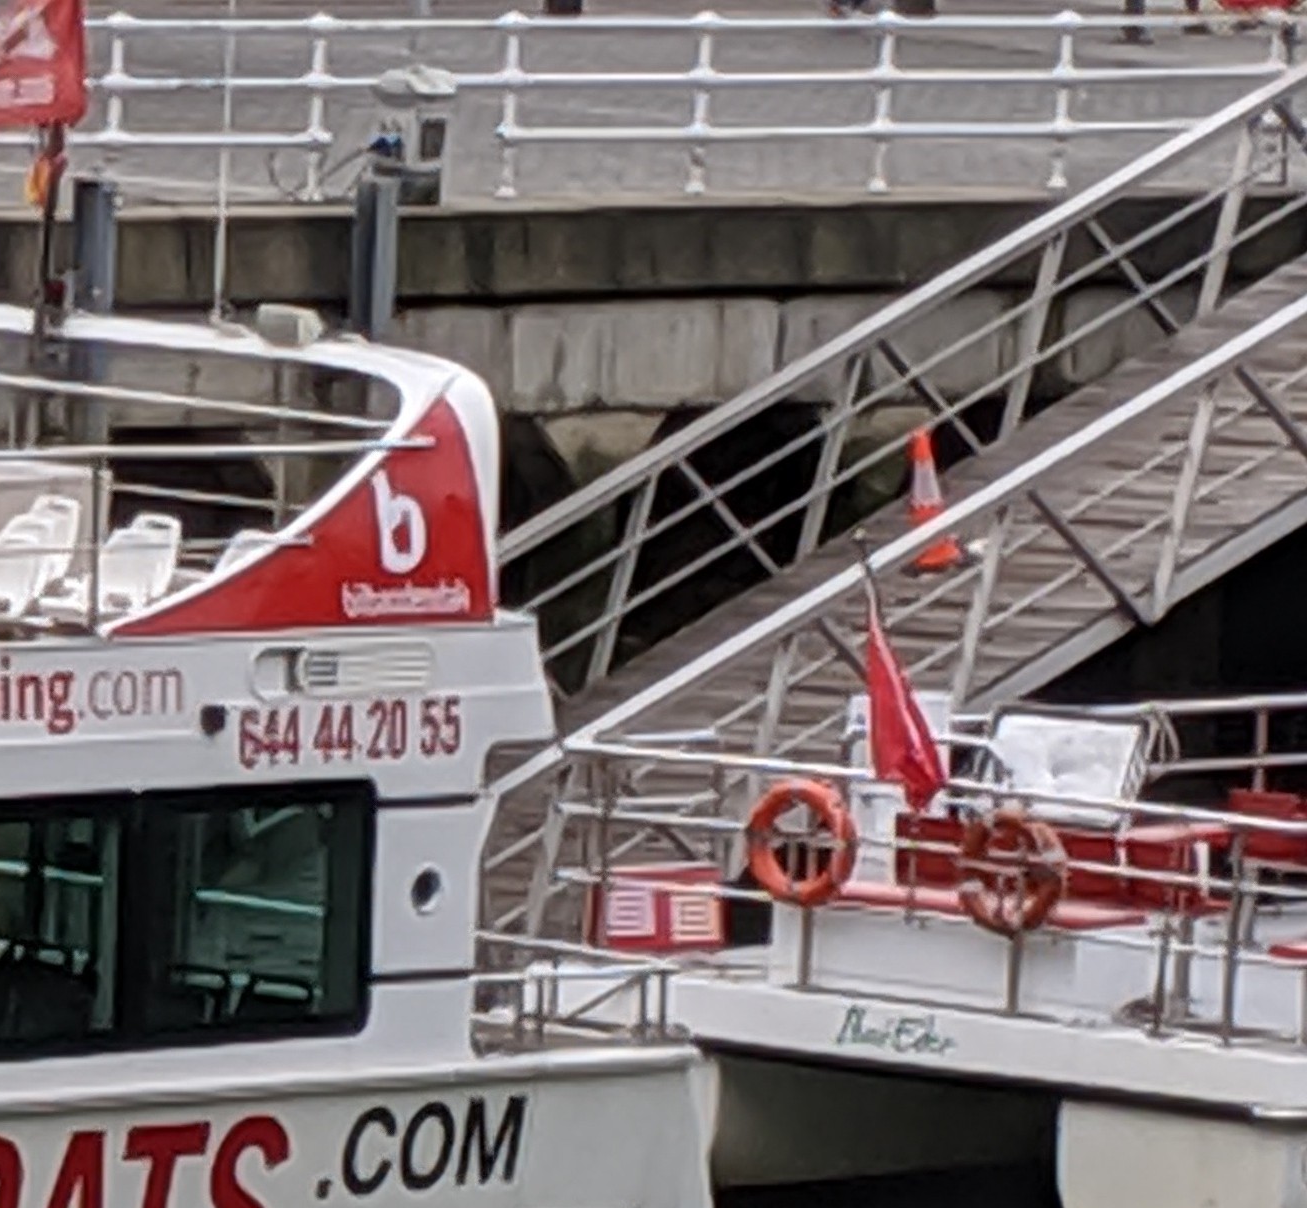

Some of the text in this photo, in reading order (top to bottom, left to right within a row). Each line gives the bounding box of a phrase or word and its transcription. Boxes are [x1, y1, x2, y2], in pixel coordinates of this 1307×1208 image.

[371, 469, 427, 573] b
[239, 695, 461, 769] 644 44 20 55
